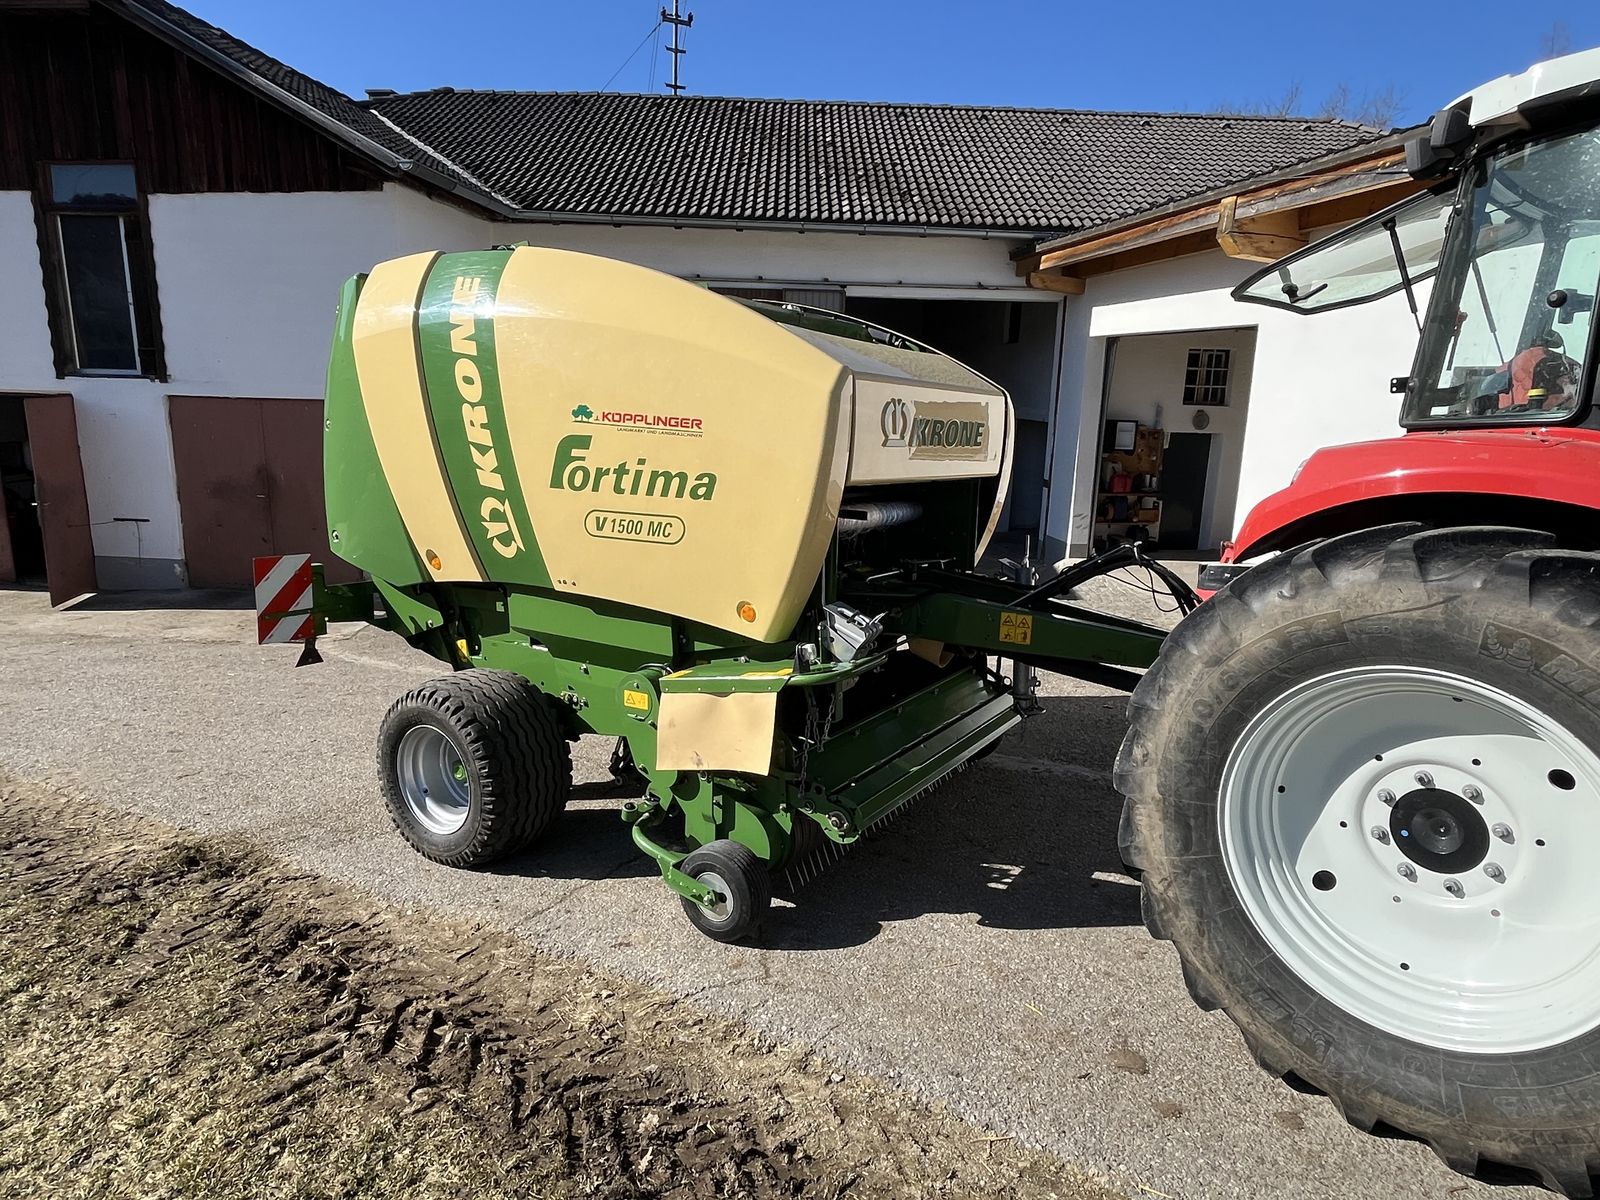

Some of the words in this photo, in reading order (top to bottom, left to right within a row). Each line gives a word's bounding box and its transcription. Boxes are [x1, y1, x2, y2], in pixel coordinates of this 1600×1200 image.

[450, 276, 505, 492] KRONE
[908, 417, 986, 449] KRONE
[549, 434, 718, 501] Fortima
[595, 516, 608, 532] V
[610, 518, 643, 536] 1500
[647, 521, 673, 538] MC
